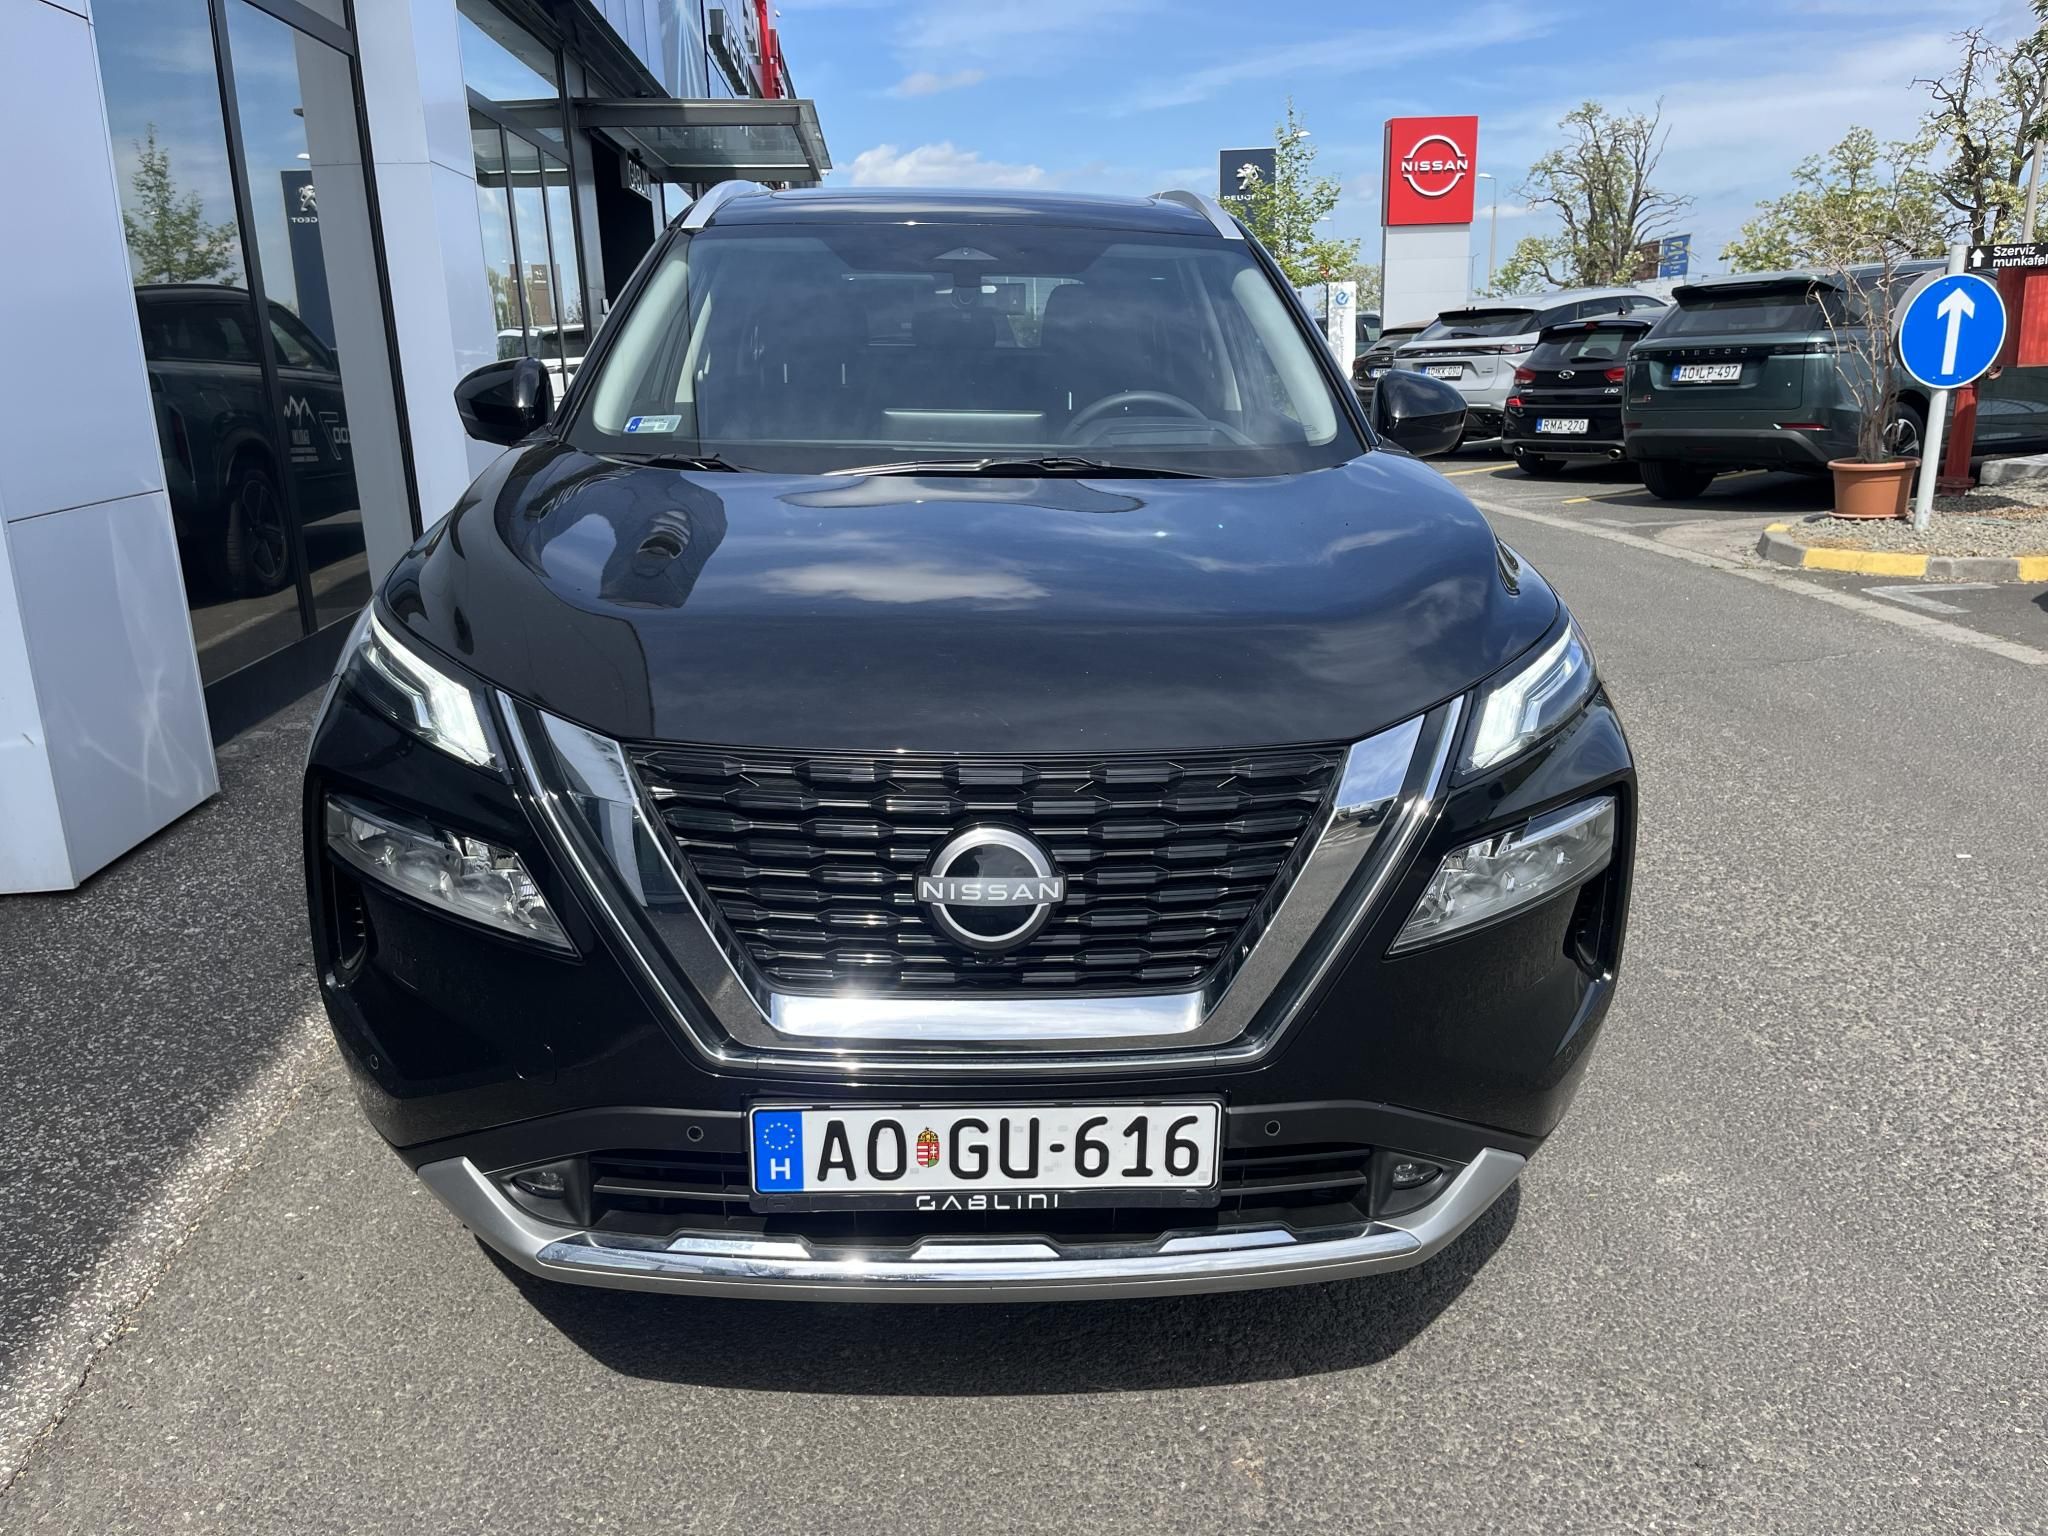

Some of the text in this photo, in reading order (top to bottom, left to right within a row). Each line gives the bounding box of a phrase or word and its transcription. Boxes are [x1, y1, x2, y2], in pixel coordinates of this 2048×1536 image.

[1401, 160, 1468, 172] NISSAN
[1993, 245, 2036, 257] Szerviz
[1543, 420, 1585, 431] RMA-270
[922, 881, 1059, 901] NISSAN
[817, 1115, 1200, 1182] AO GU-616
[770, 1157, 791, 1181] H
[916, 1193, 1058, 1211] GABLINI
